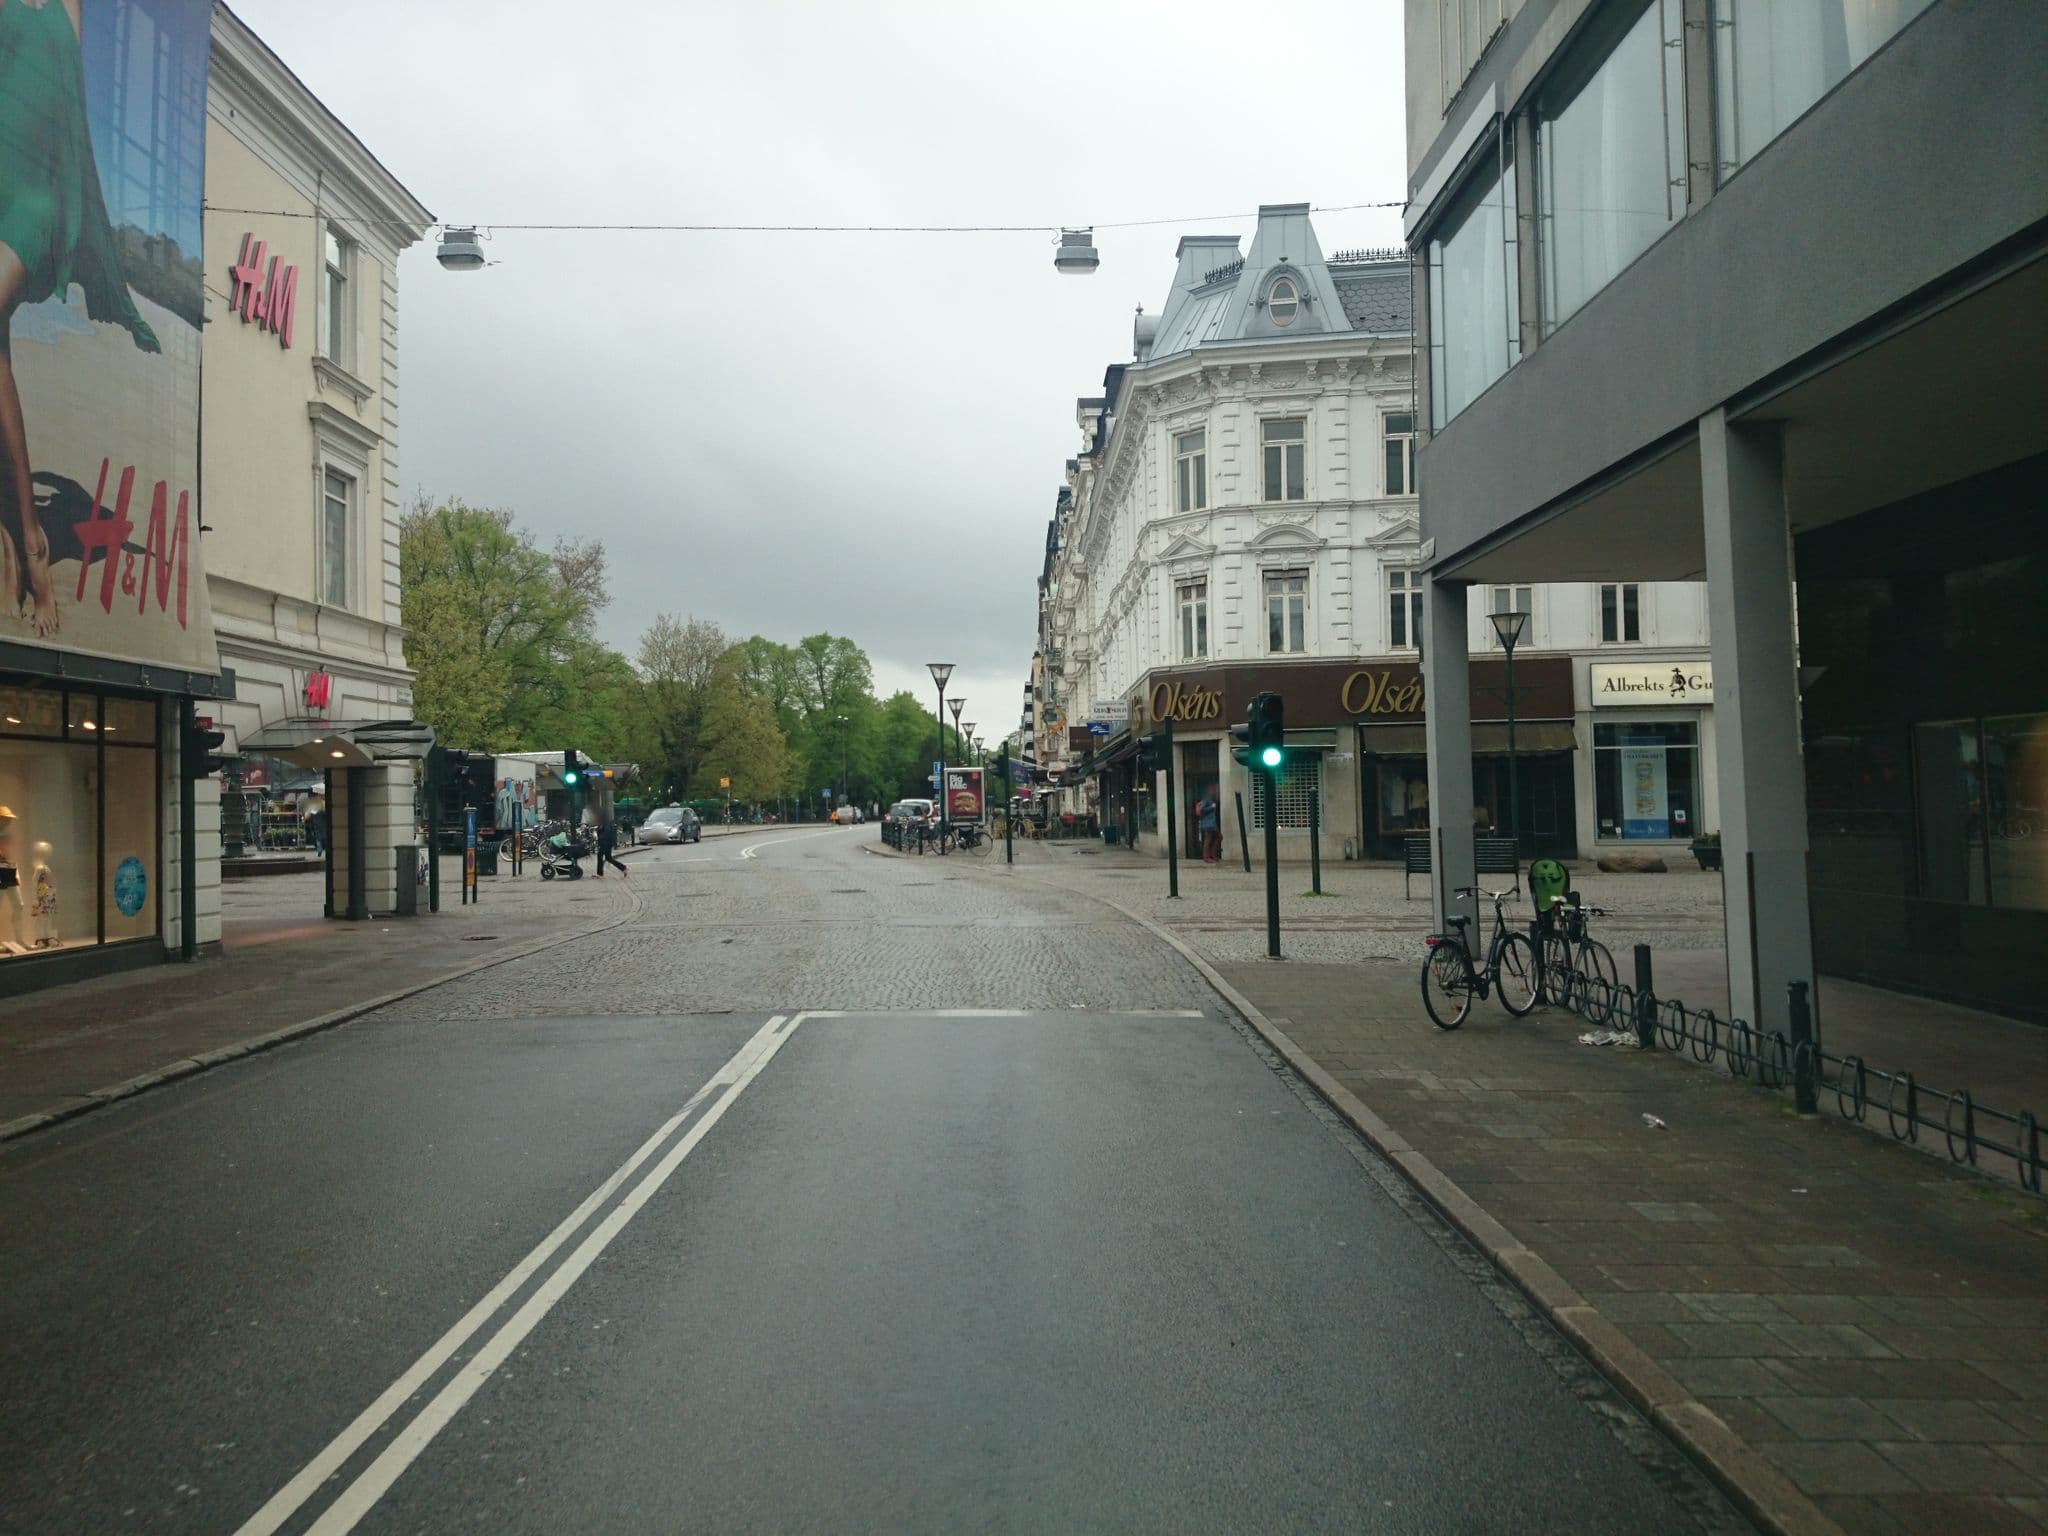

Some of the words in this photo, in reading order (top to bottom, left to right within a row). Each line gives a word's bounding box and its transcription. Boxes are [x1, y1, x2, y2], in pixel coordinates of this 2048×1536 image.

[229, 231, 298, 350] H&M
[73, 456, 189, 631] H&M
[1151, 682, 1223, 722] Olséns
[1602, 676, 1665, 692] Albrekts
